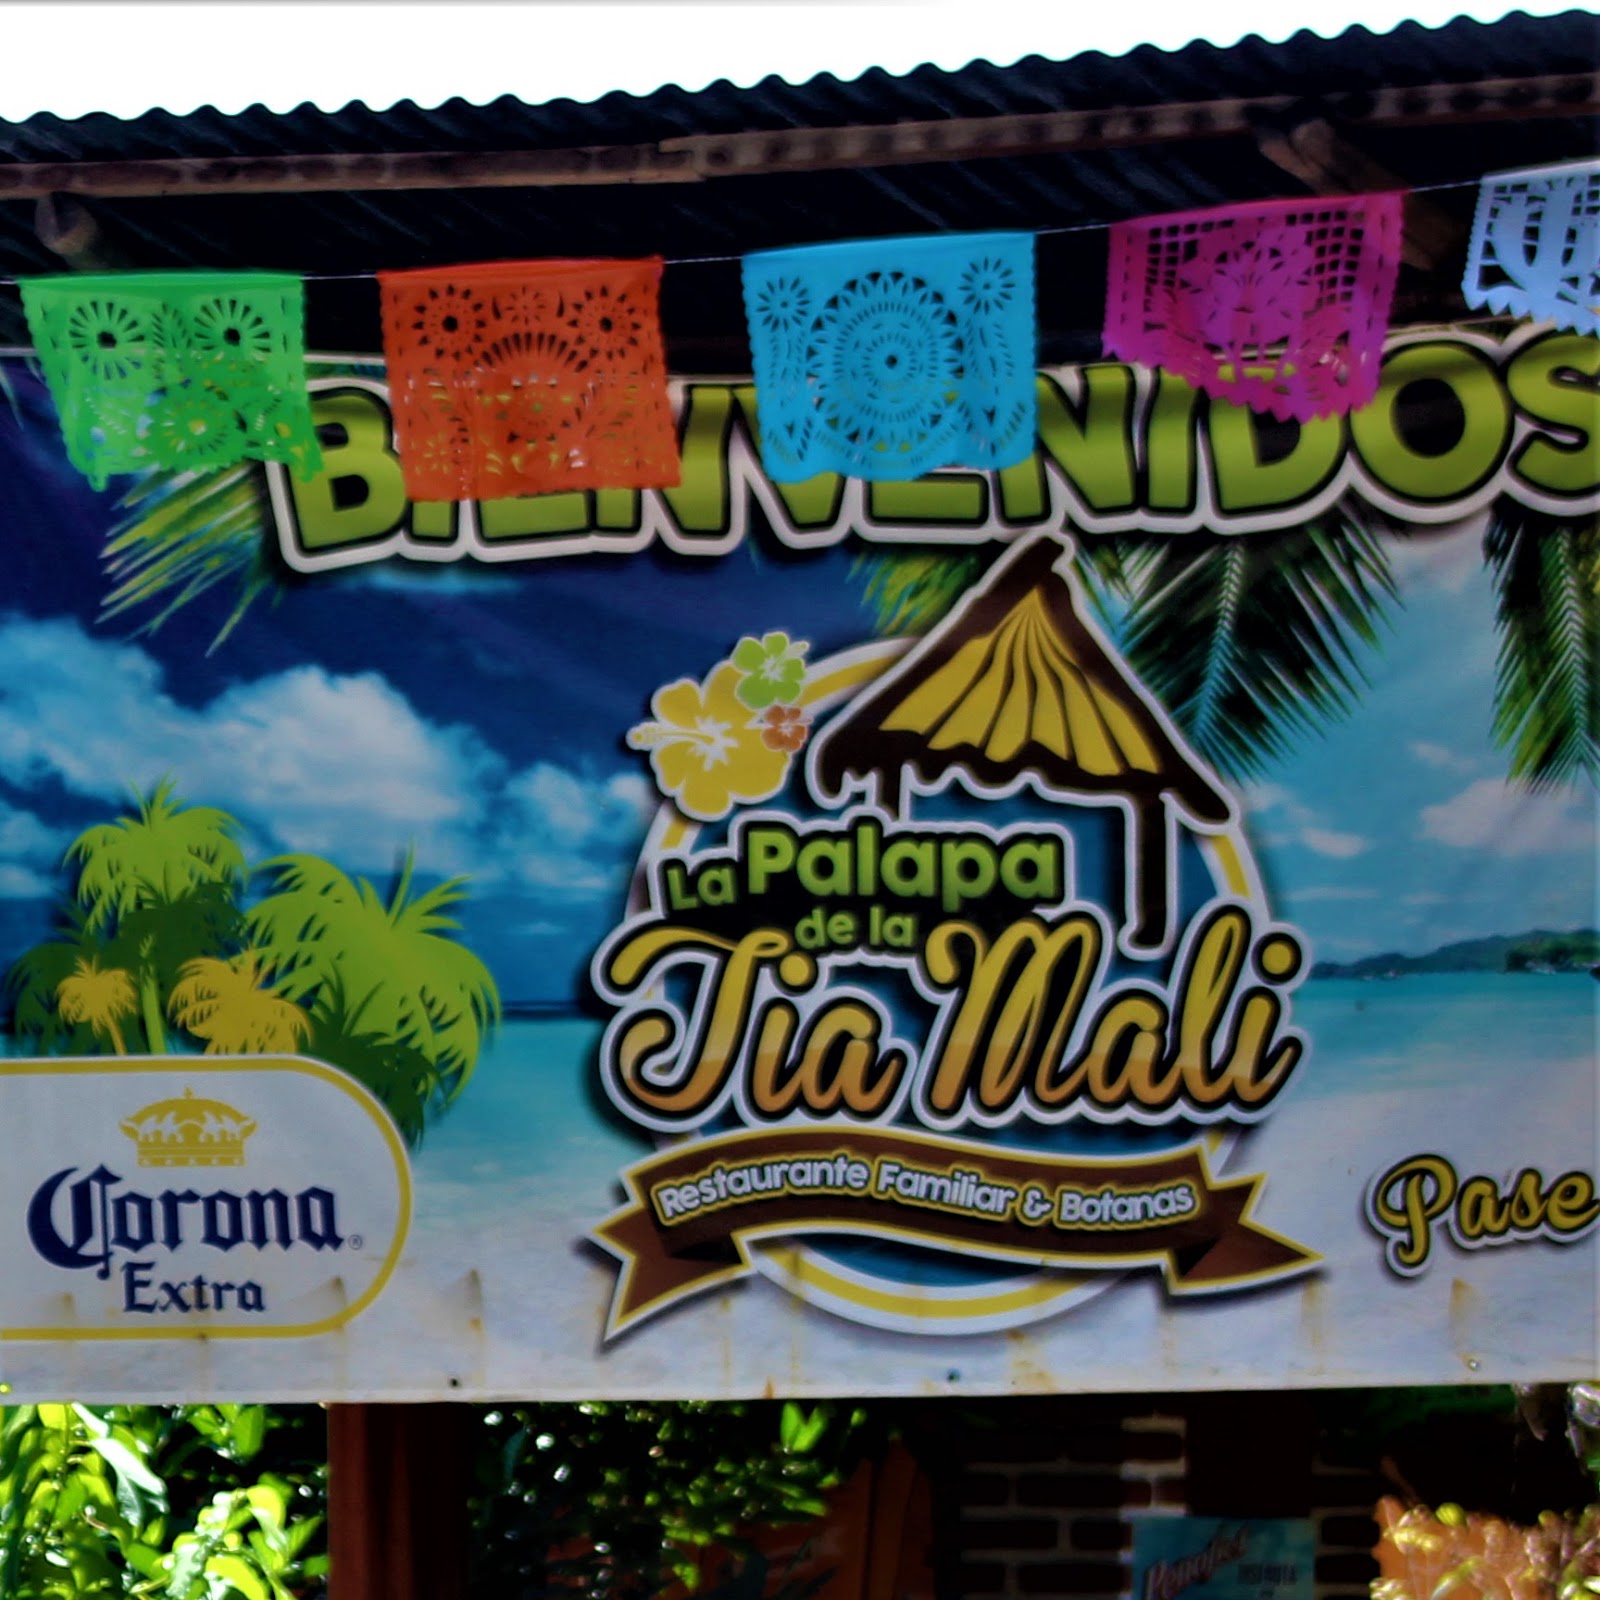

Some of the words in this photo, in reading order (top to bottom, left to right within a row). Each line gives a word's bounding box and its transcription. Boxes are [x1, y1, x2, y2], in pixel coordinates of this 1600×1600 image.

[280, 322, 1600, 560] BNNIDOS
[666, 864, 737, 911] La
[746, 824, 1061, 911] Palapa
[794, 907, 854, 949] de
[869, 906, 914, 947] la
[608, 929, 906, 1113] Tia
[924, 904, 1302, 1112] Mali
[26, 1163, 346, 1281] Corona
[657, 1155, 868, 1219] Restaurante
[877, 1161, 1014, 1215] Familiar
[1022, 1187, 1052, 1215] &
[1059, 1183, 1196, 1224] Botanas
[119, 1261, 267, 1314] Extra
